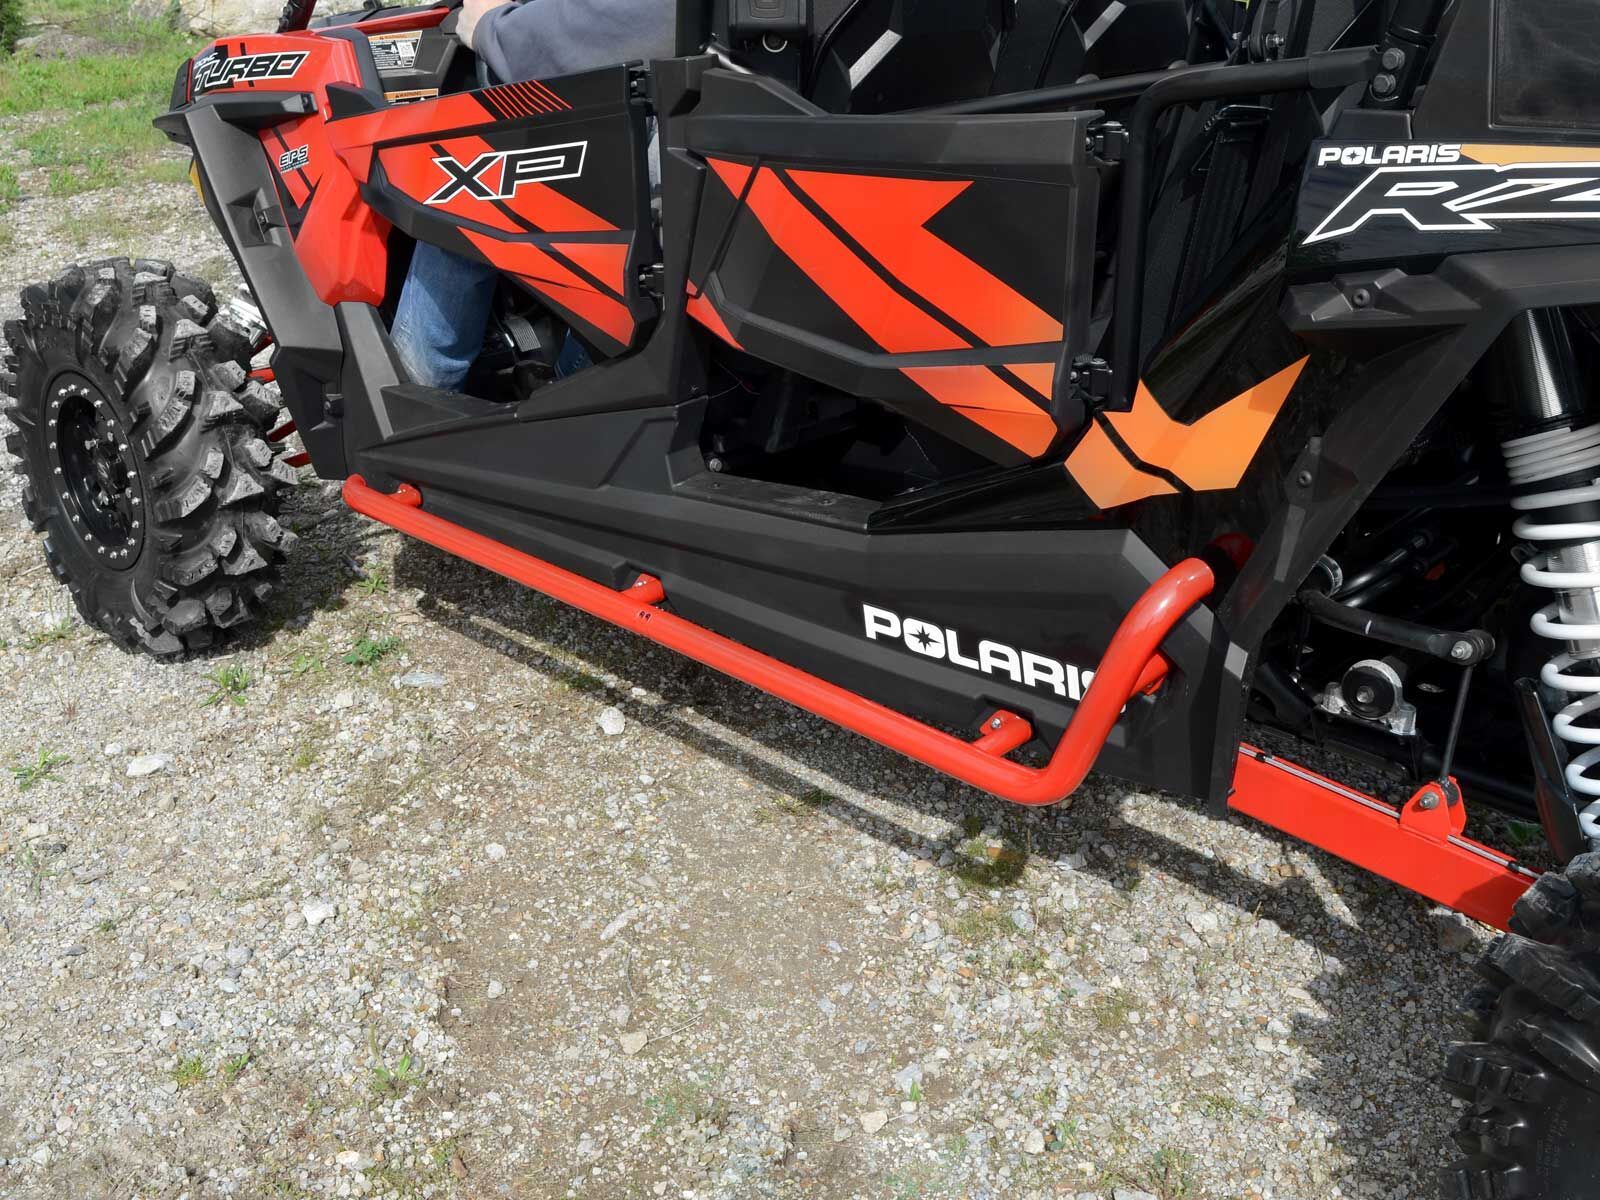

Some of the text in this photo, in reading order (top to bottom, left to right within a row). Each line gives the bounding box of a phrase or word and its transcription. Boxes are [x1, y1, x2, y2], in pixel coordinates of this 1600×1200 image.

[194, 51, 310, 91] TURBO
[279, 144, 309, 167] EPS
[423, 141, 587, 204] XP
[1318, 144, 1462, 166] POLARIS
[863, 603, 1127, 713] POLARI
